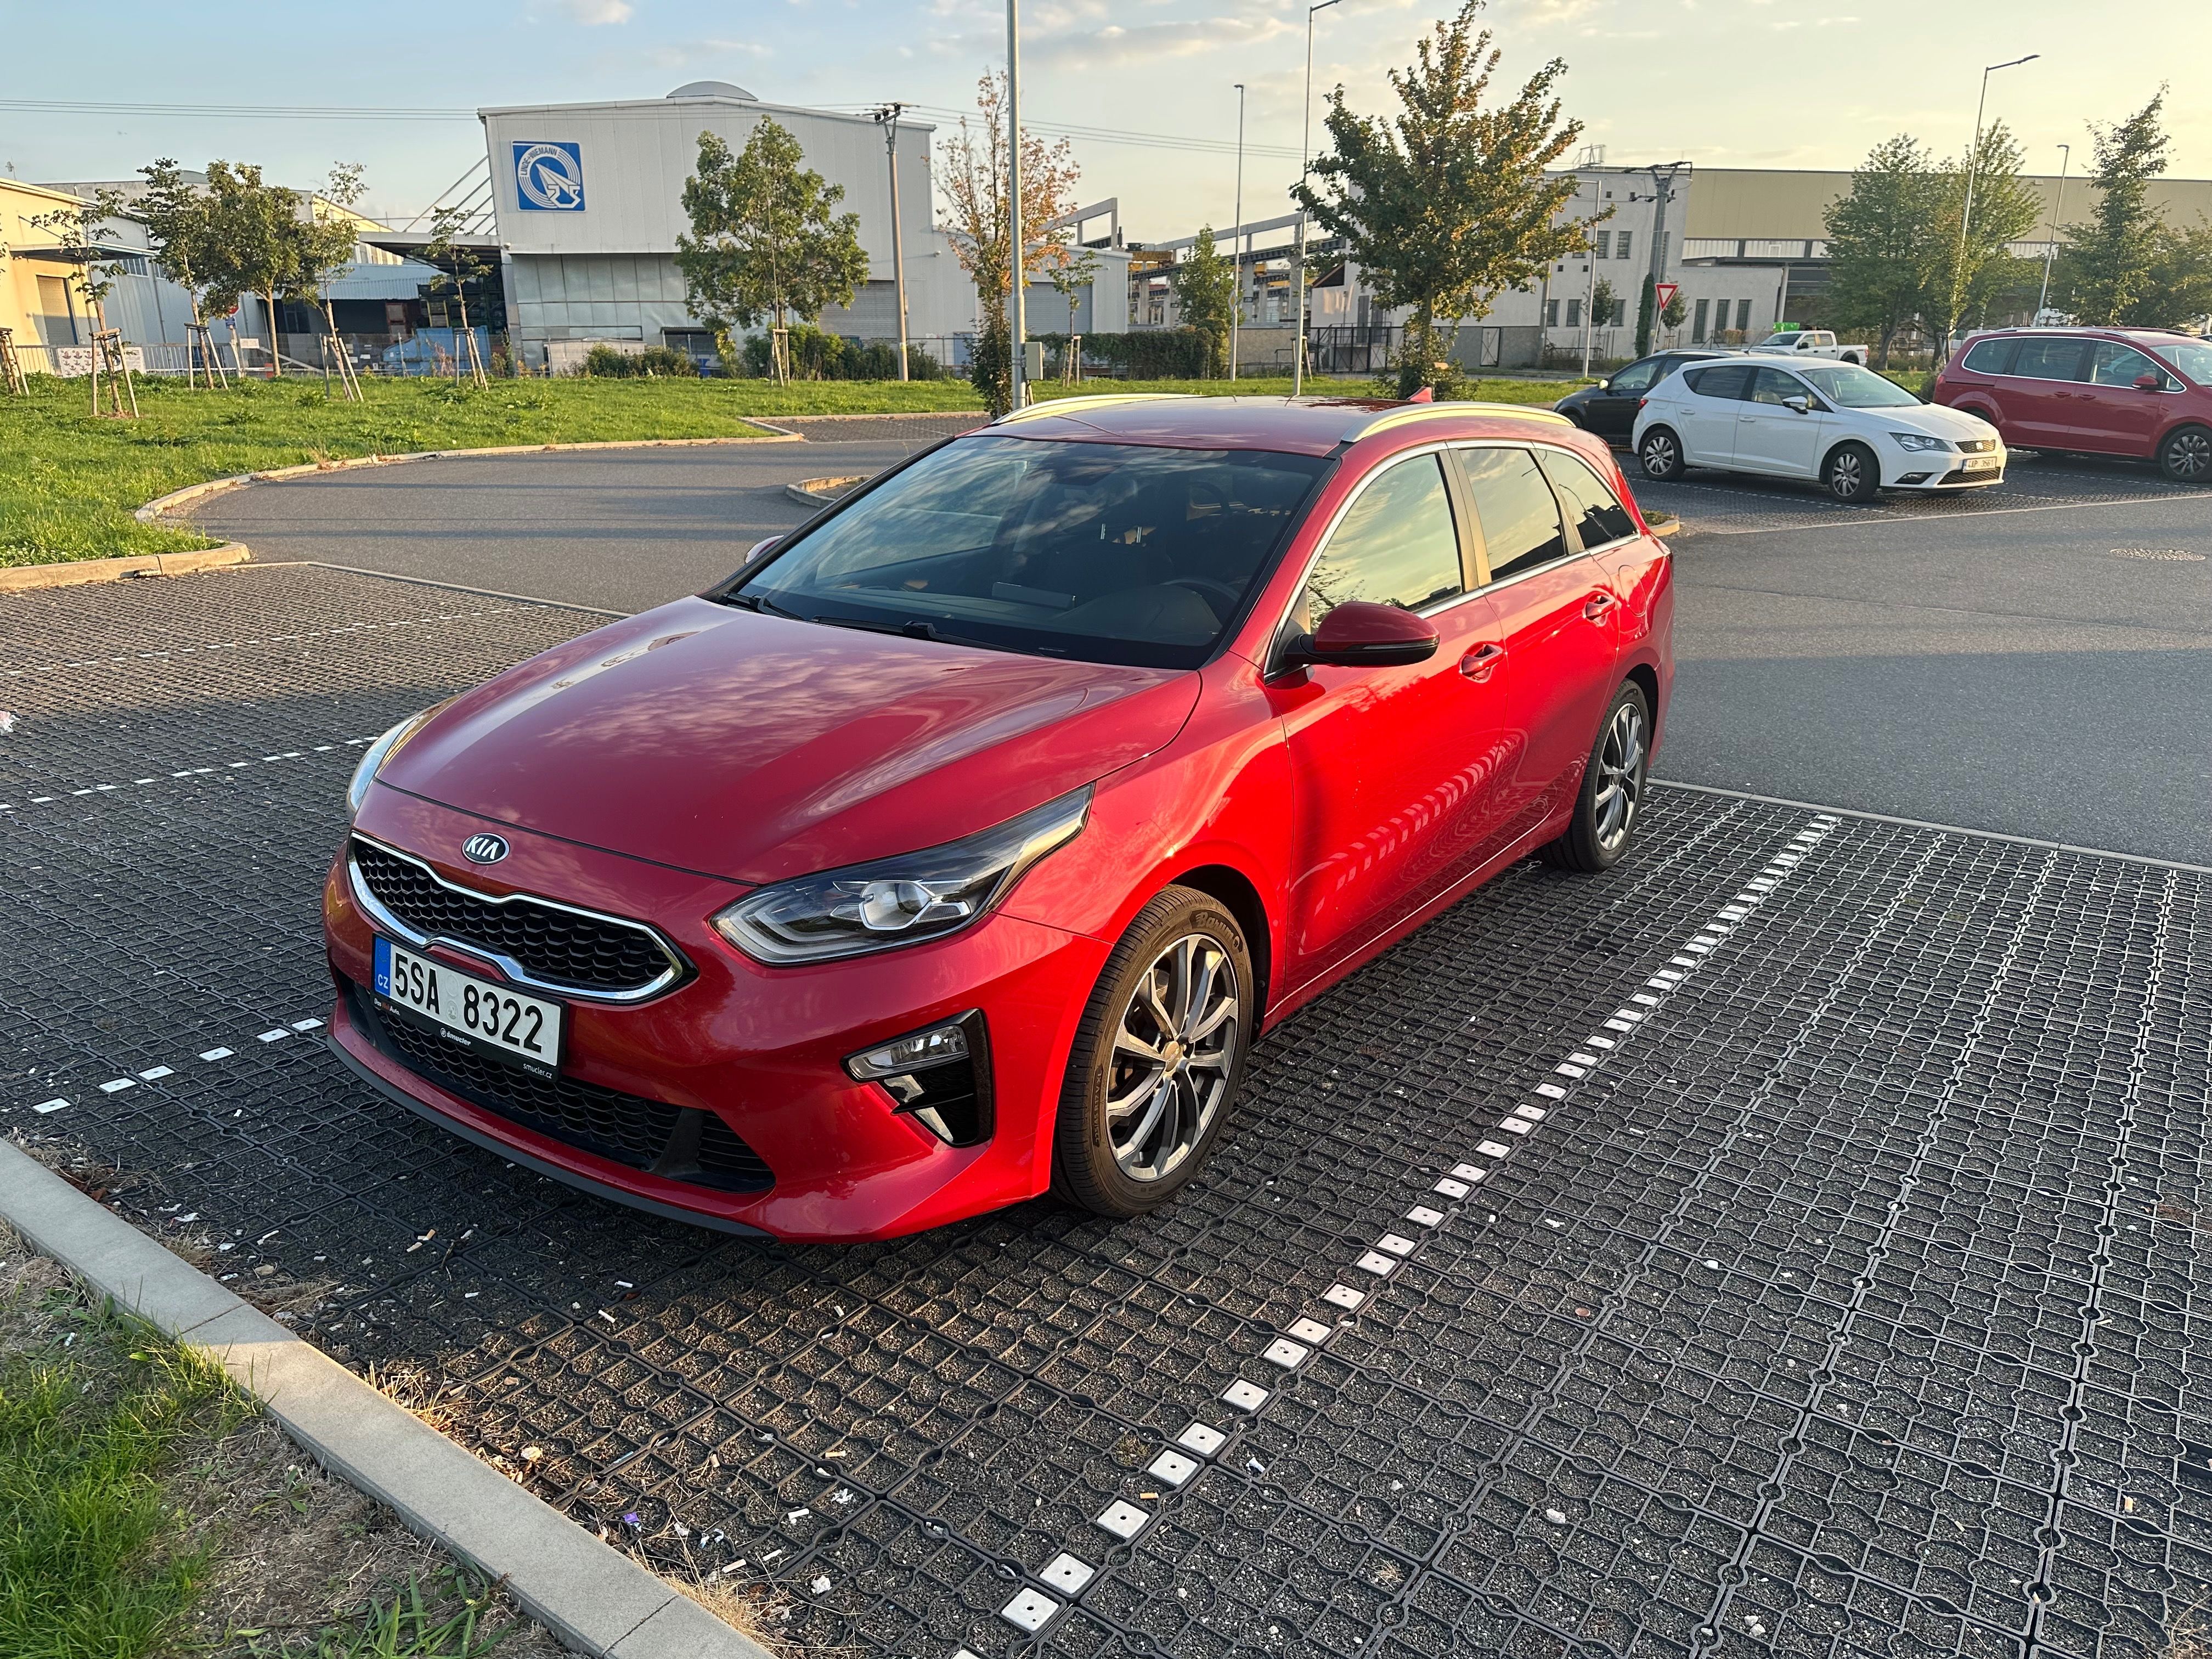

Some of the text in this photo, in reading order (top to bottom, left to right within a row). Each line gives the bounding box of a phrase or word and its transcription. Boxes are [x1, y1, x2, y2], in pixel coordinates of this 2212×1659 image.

[466, 836, 500, 860] KIA
[1195, 912, 1234, 941] Barum
[377, 973, 388, 989] CZ
[395, 952, 544, 1053] 5SA 8322
[523, 1063, 552, 1079] smucler.cz
